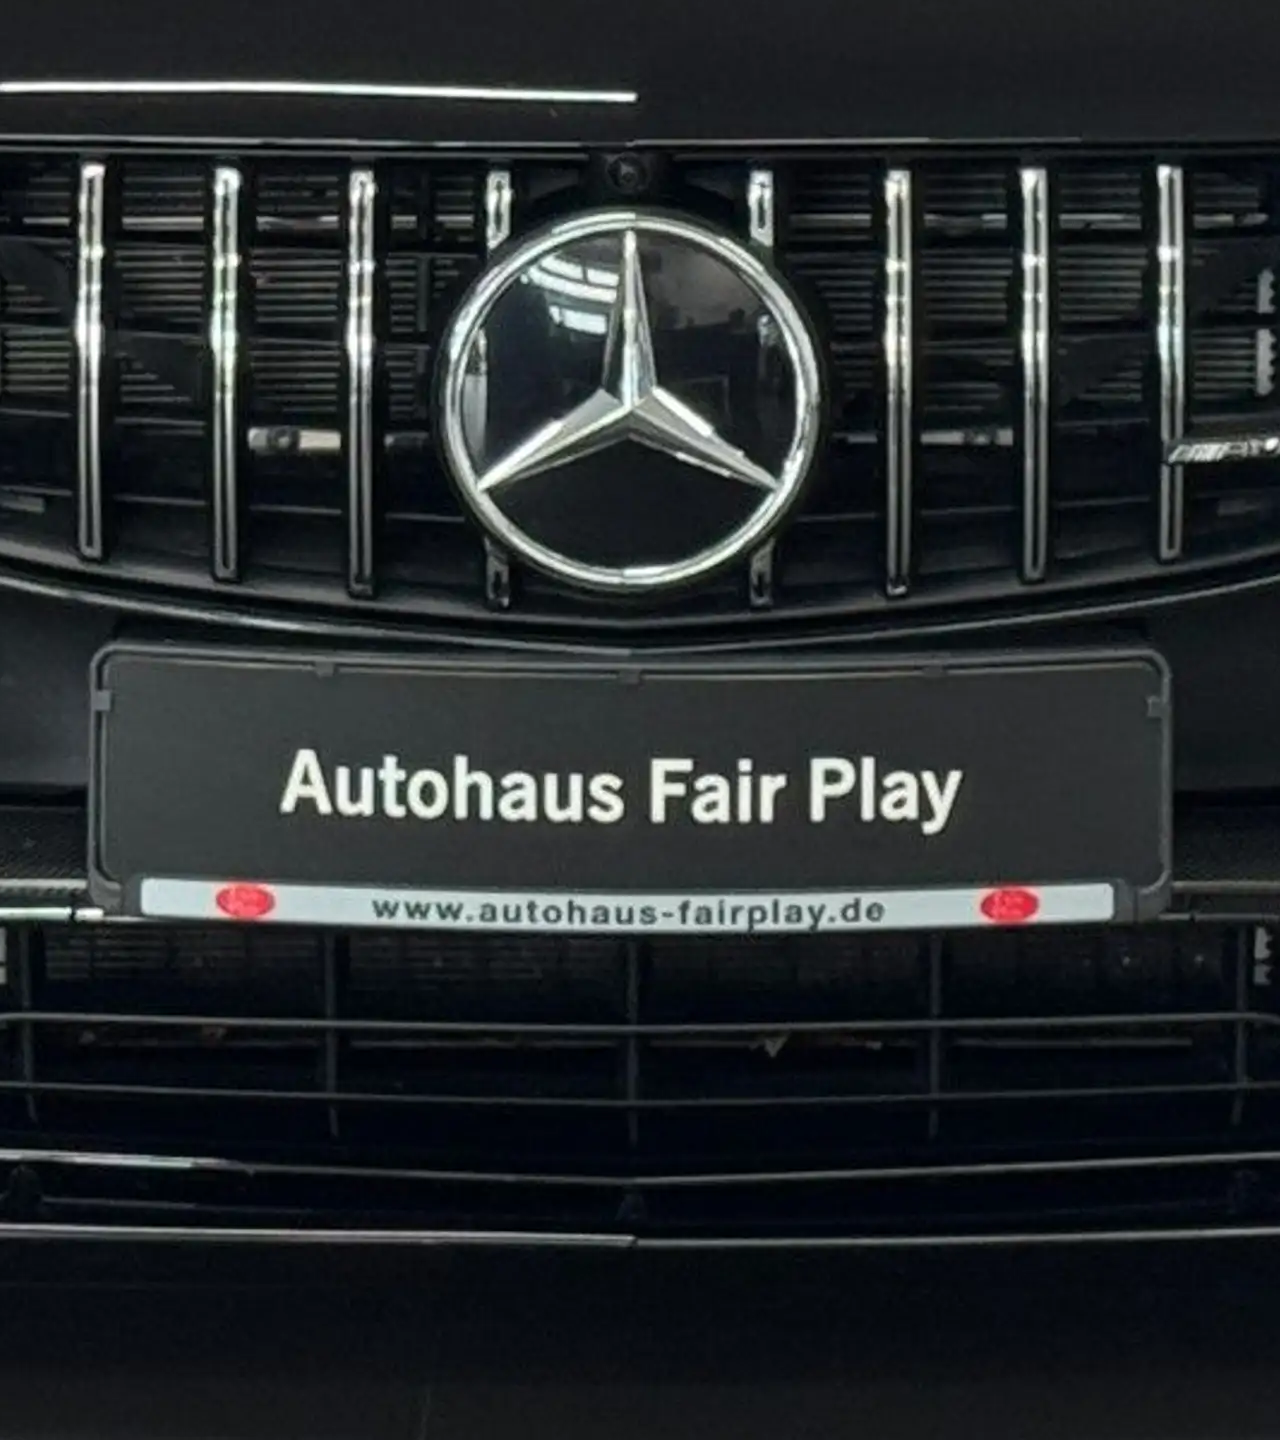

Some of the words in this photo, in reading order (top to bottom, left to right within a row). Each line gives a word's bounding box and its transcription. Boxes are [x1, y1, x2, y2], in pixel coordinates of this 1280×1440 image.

[279, 748, 625, 824] Autohaus
[650, 757, 787, 824] Fair
[809, 755, 963, 835] Play
[372, 899, 886, 931] www.autohaus-fairplay.de
